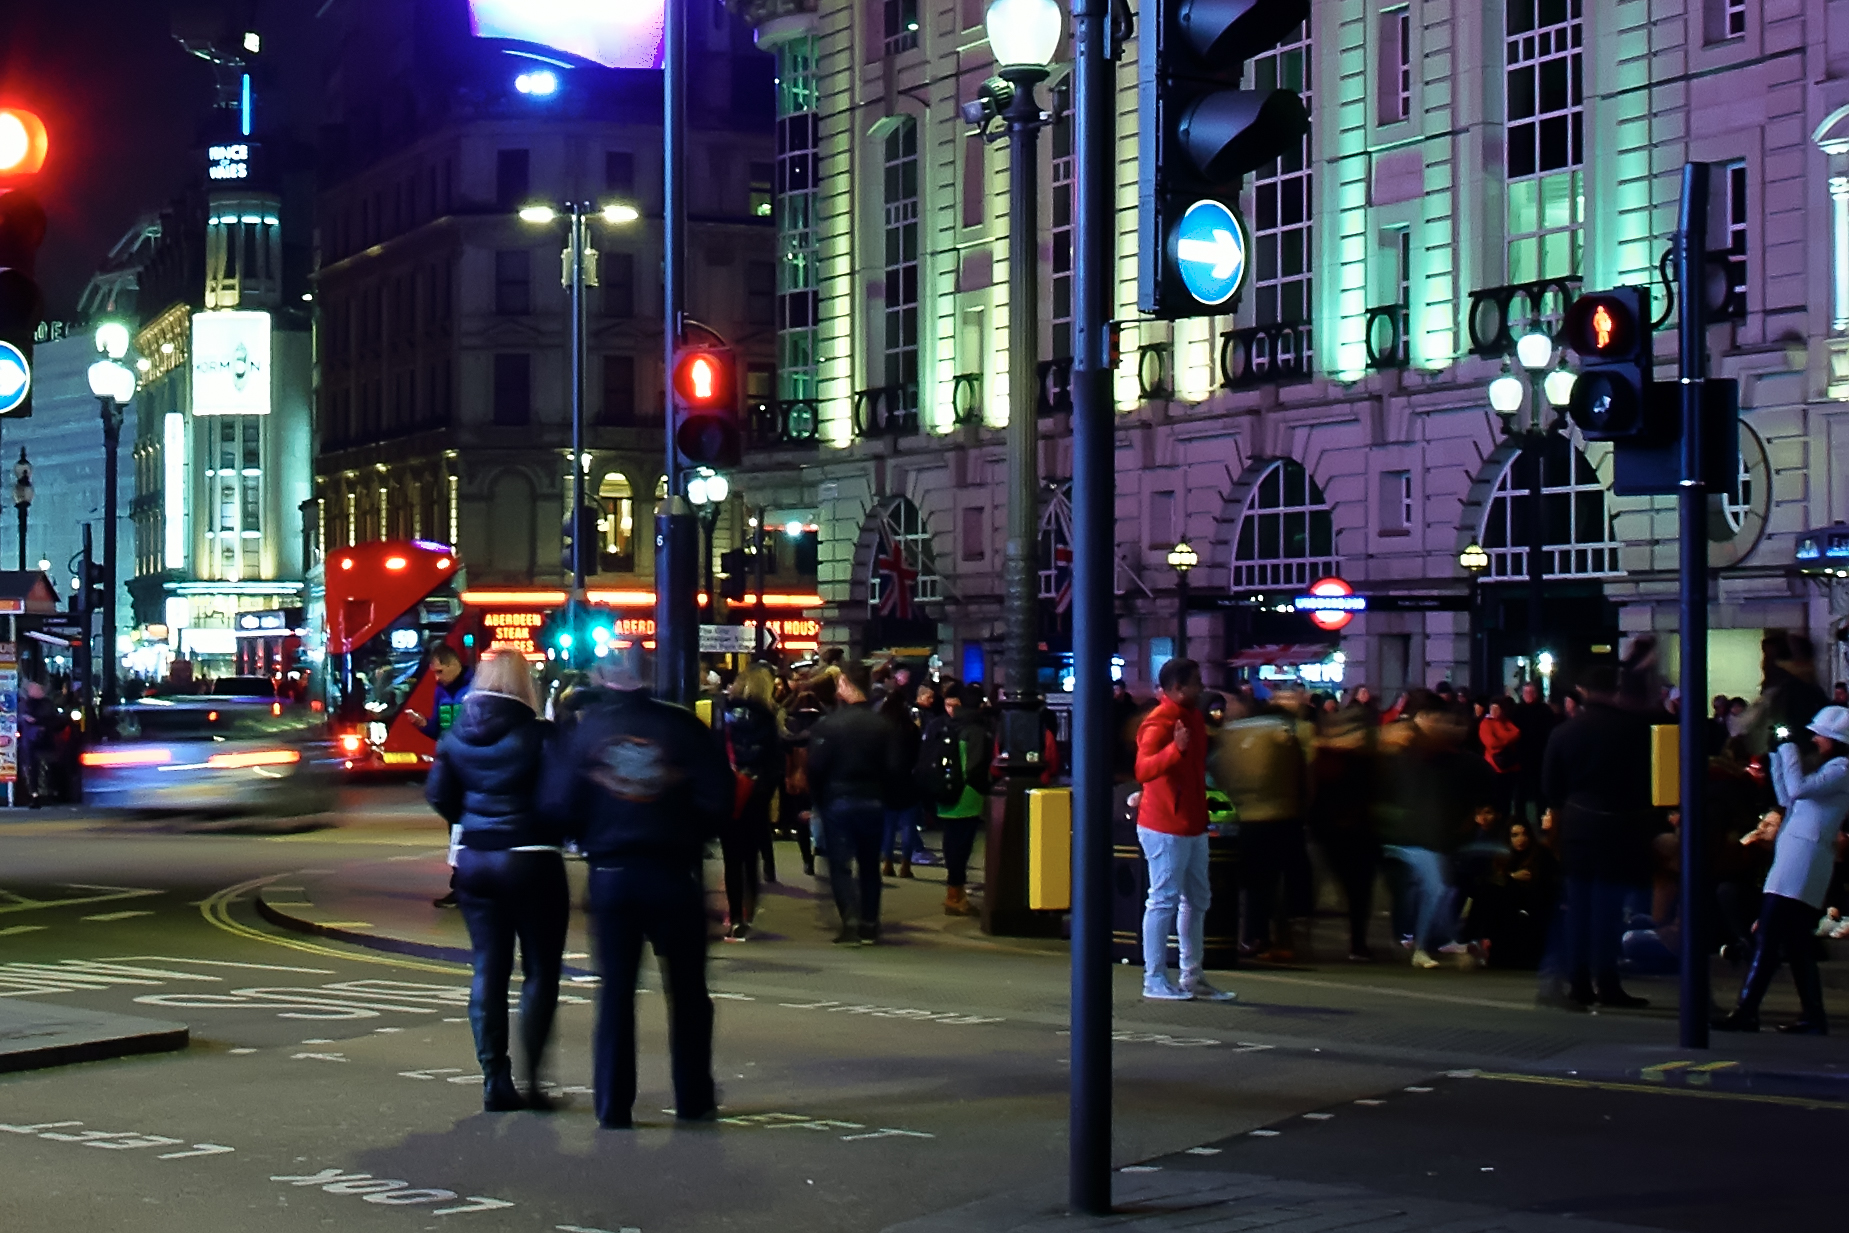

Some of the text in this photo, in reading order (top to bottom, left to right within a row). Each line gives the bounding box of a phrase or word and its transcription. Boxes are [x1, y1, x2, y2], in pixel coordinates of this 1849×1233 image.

[656, 535, 664, 546] 6
[484, 613, 541, 626] ABERDEEN
[496, 627, 529, 639] STEAK
[614, 620, 655, 635] ABERD
[784, 620, 820, 635] HOUS
[1055, 1029, 1276, 1053] LOO
[270, 1168, 515, 1215] LOOK
